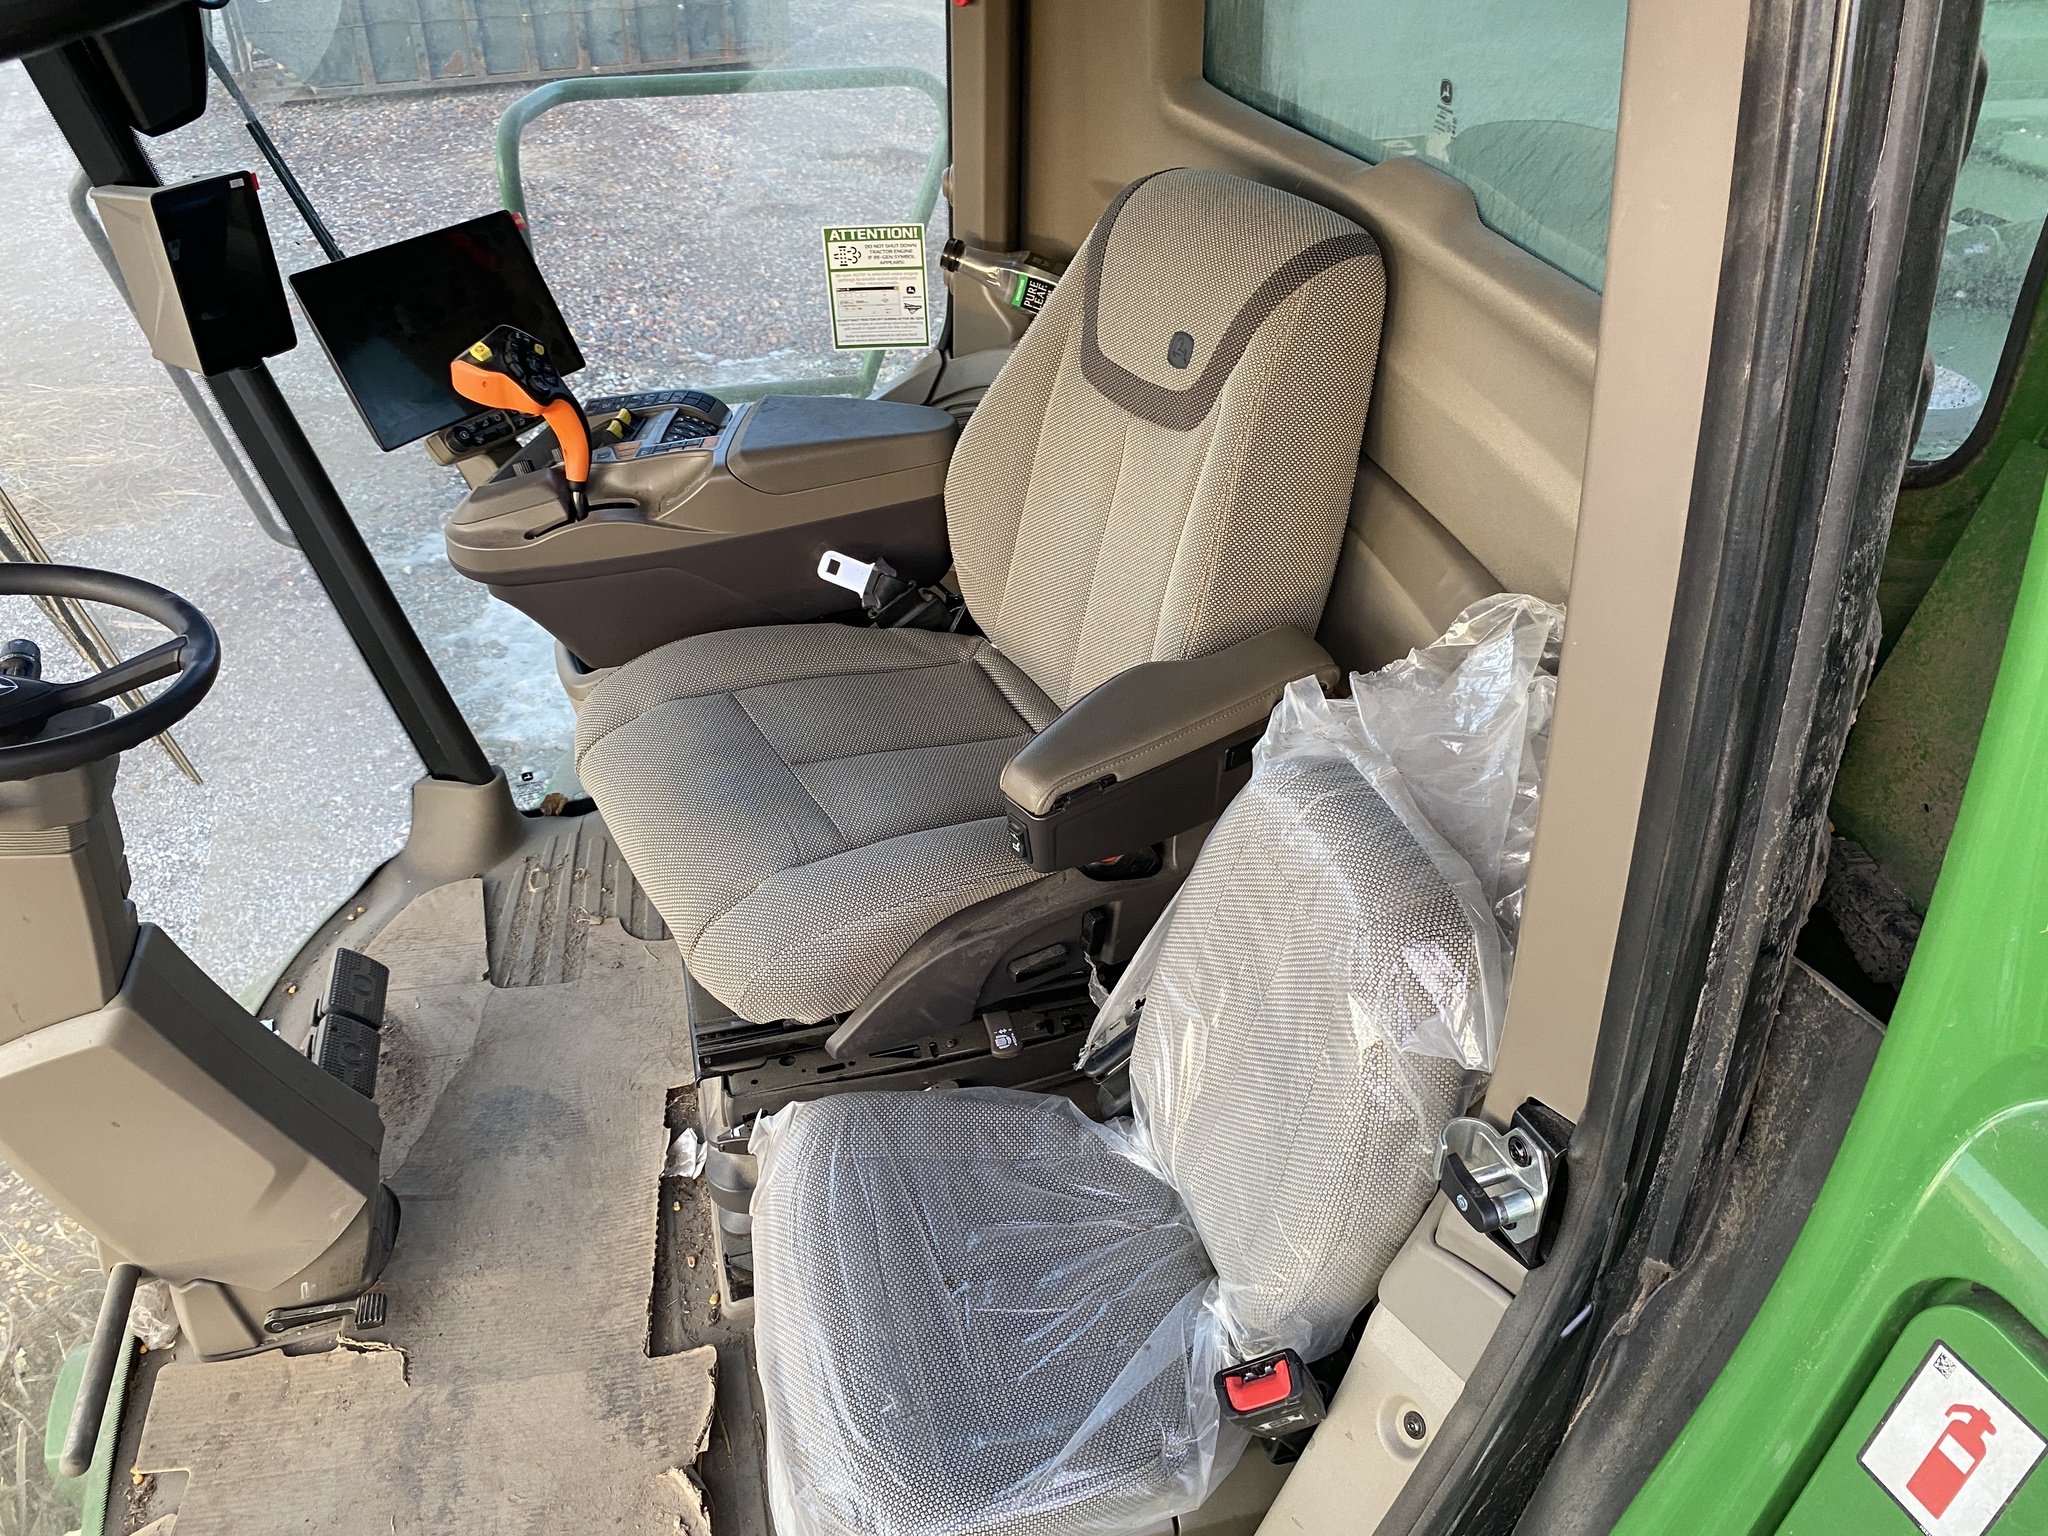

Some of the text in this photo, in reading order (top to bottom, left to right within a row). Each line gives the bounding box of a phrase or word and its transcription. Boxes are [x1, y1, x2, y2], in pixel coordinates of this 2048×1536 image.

[829, 227, 918, 241] ATTENTION!
[1023, 280, 1039, 308] PURE
[1032, 283, 1048, 311] LEAF
